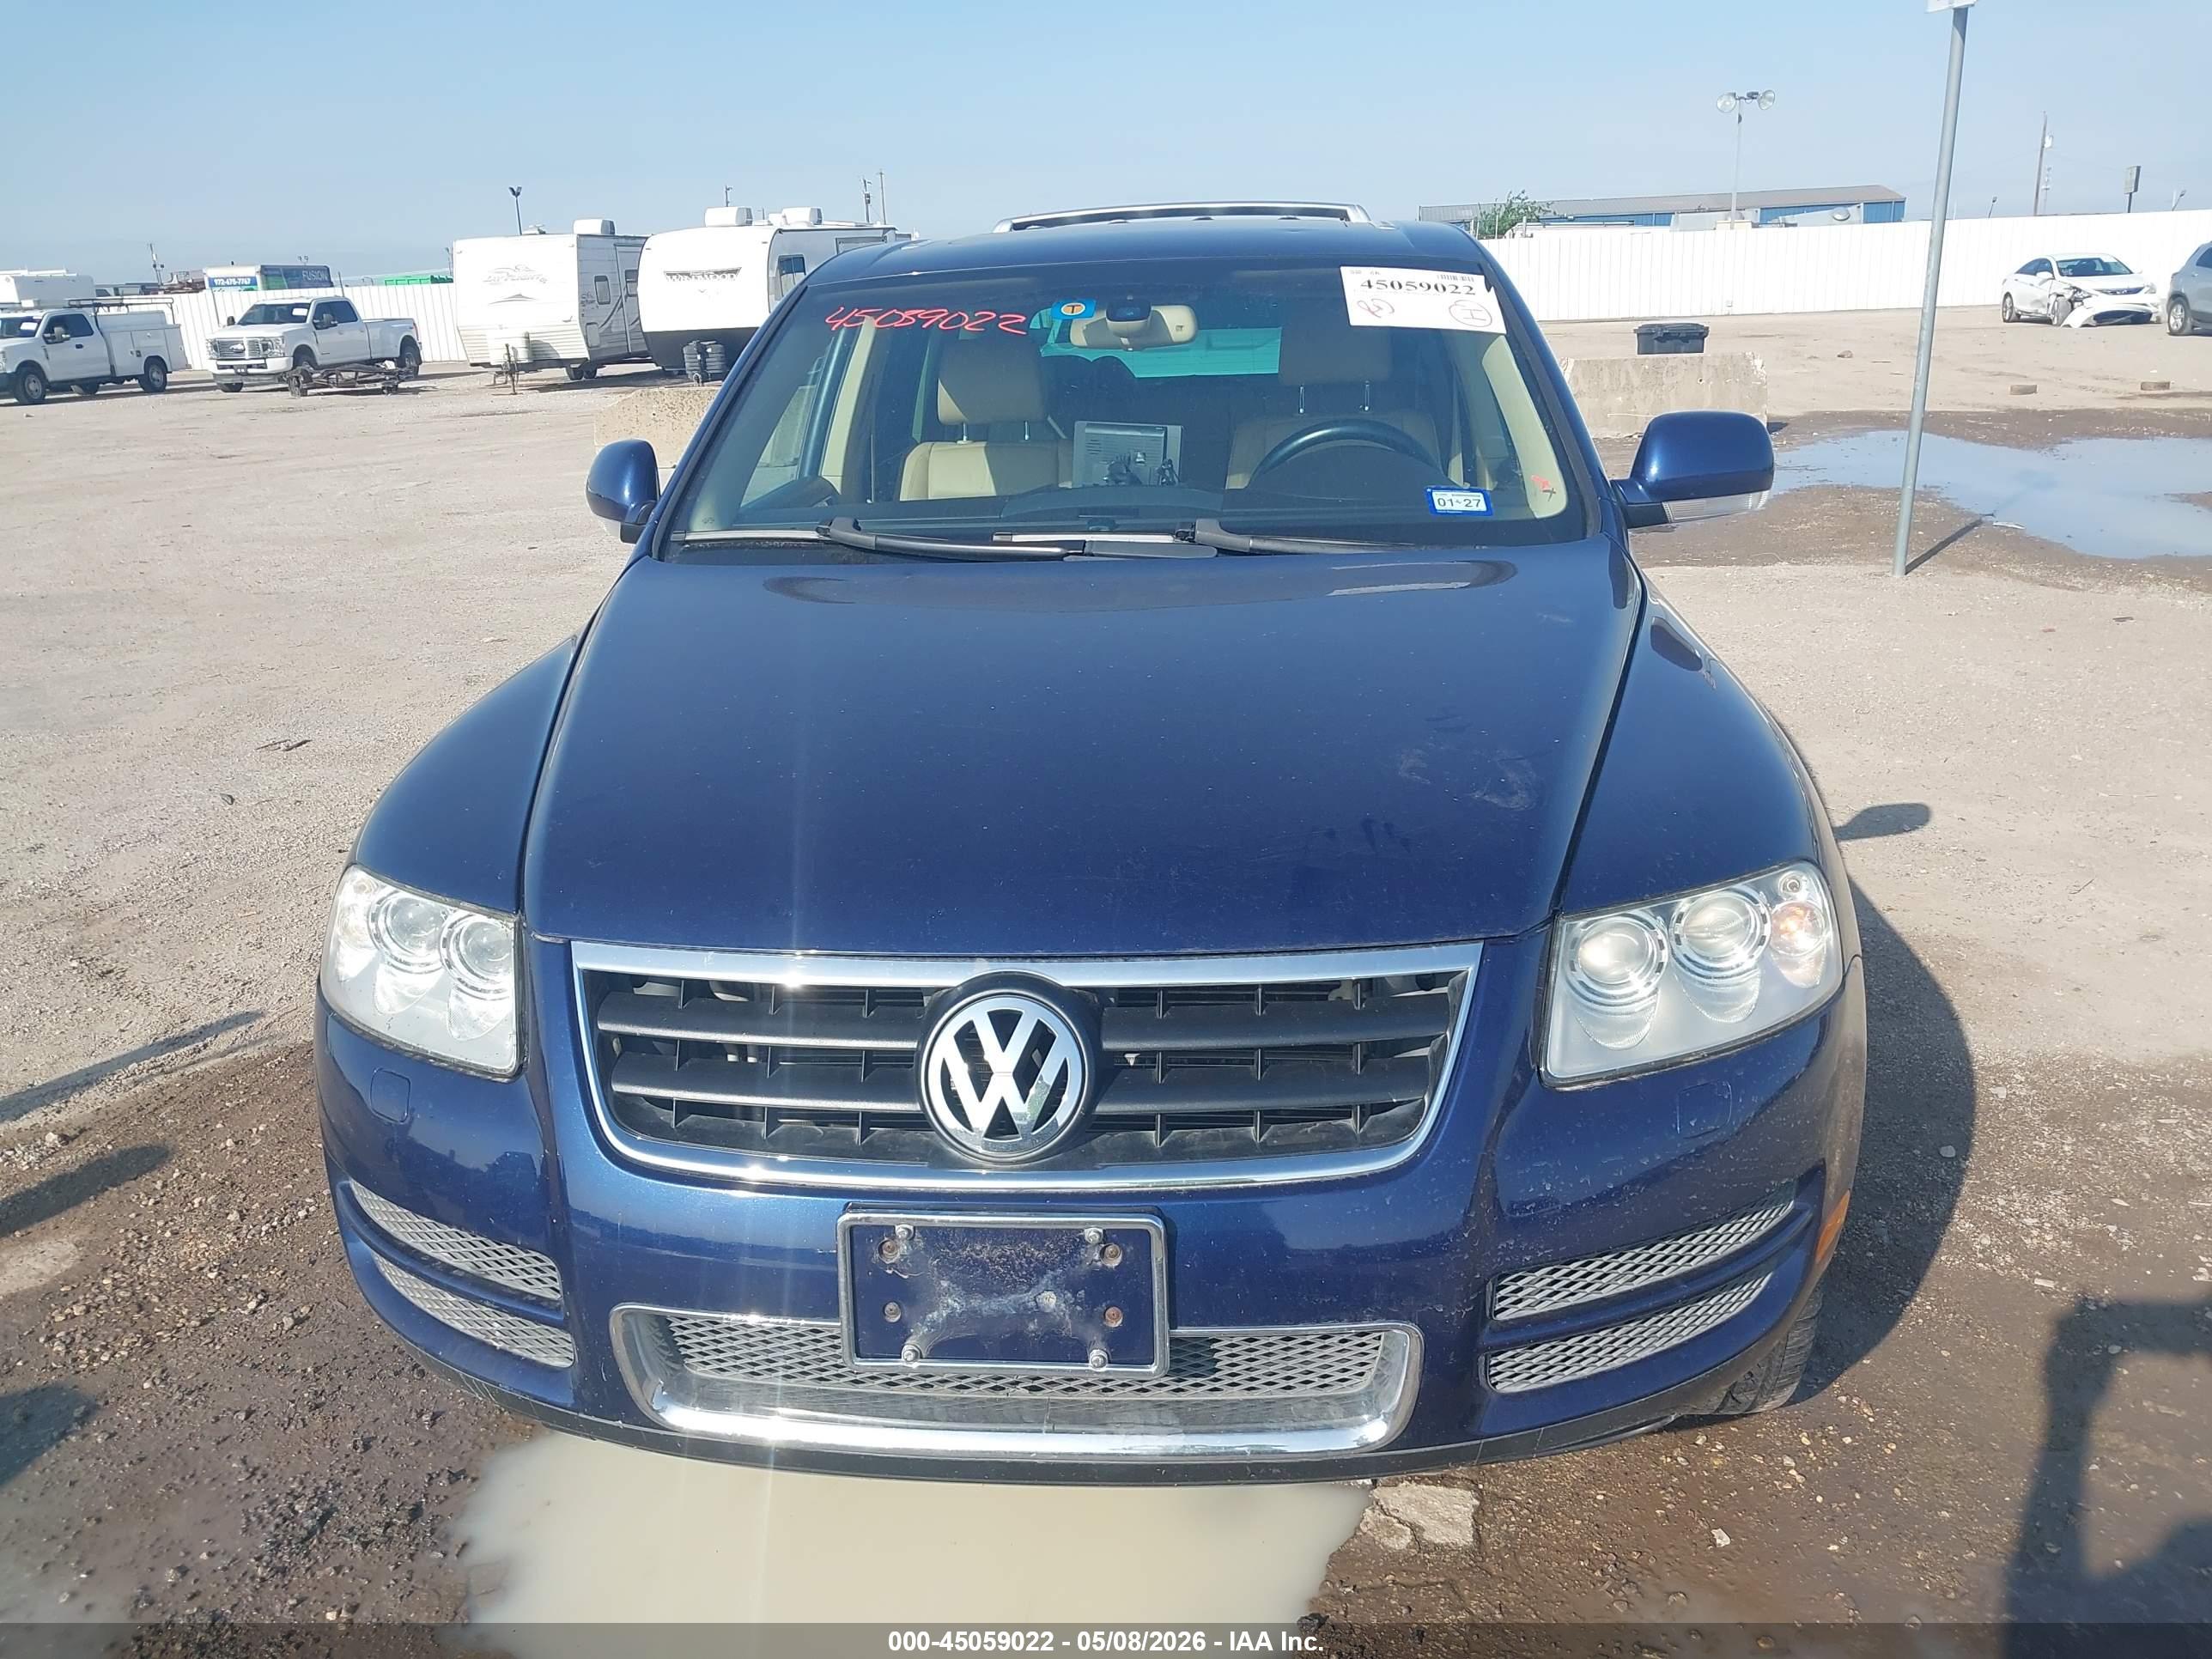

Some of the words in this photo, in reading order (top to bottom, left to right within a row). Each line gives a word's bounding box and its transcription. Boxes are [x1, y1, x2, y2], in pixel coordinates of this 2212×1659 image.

[302, 270, 329, 282] FUSION
[1360, 279, 1476, 295] 45059022
[825, 307, 1027, 335] 45059022
